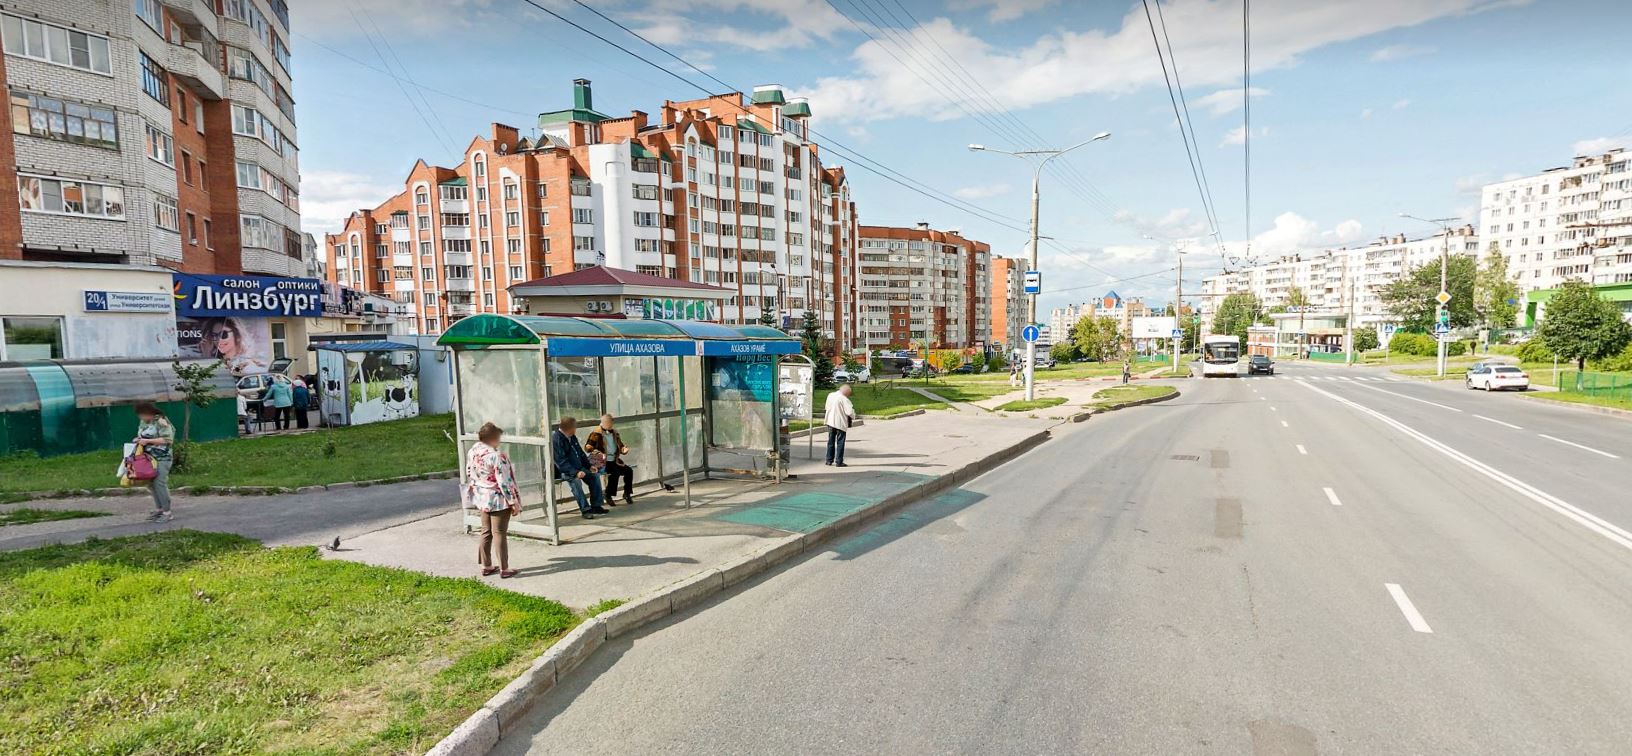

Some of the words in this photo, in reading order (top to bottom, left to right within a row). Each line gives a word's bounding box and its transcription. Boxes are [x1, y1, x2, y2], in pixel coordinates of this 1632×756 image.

[223, 279, 260, 289] салон
[277, 280, 318, 290] оптики
[86, 292, 106, 309] 20/1
[192, 286, 318, 315] Линзбург
[609, 343, 634, 355] УЛИЦА
[635, 343, 665, 353] АХАЗОВА
[730, 344, 750, 353] АХАЗОВ
